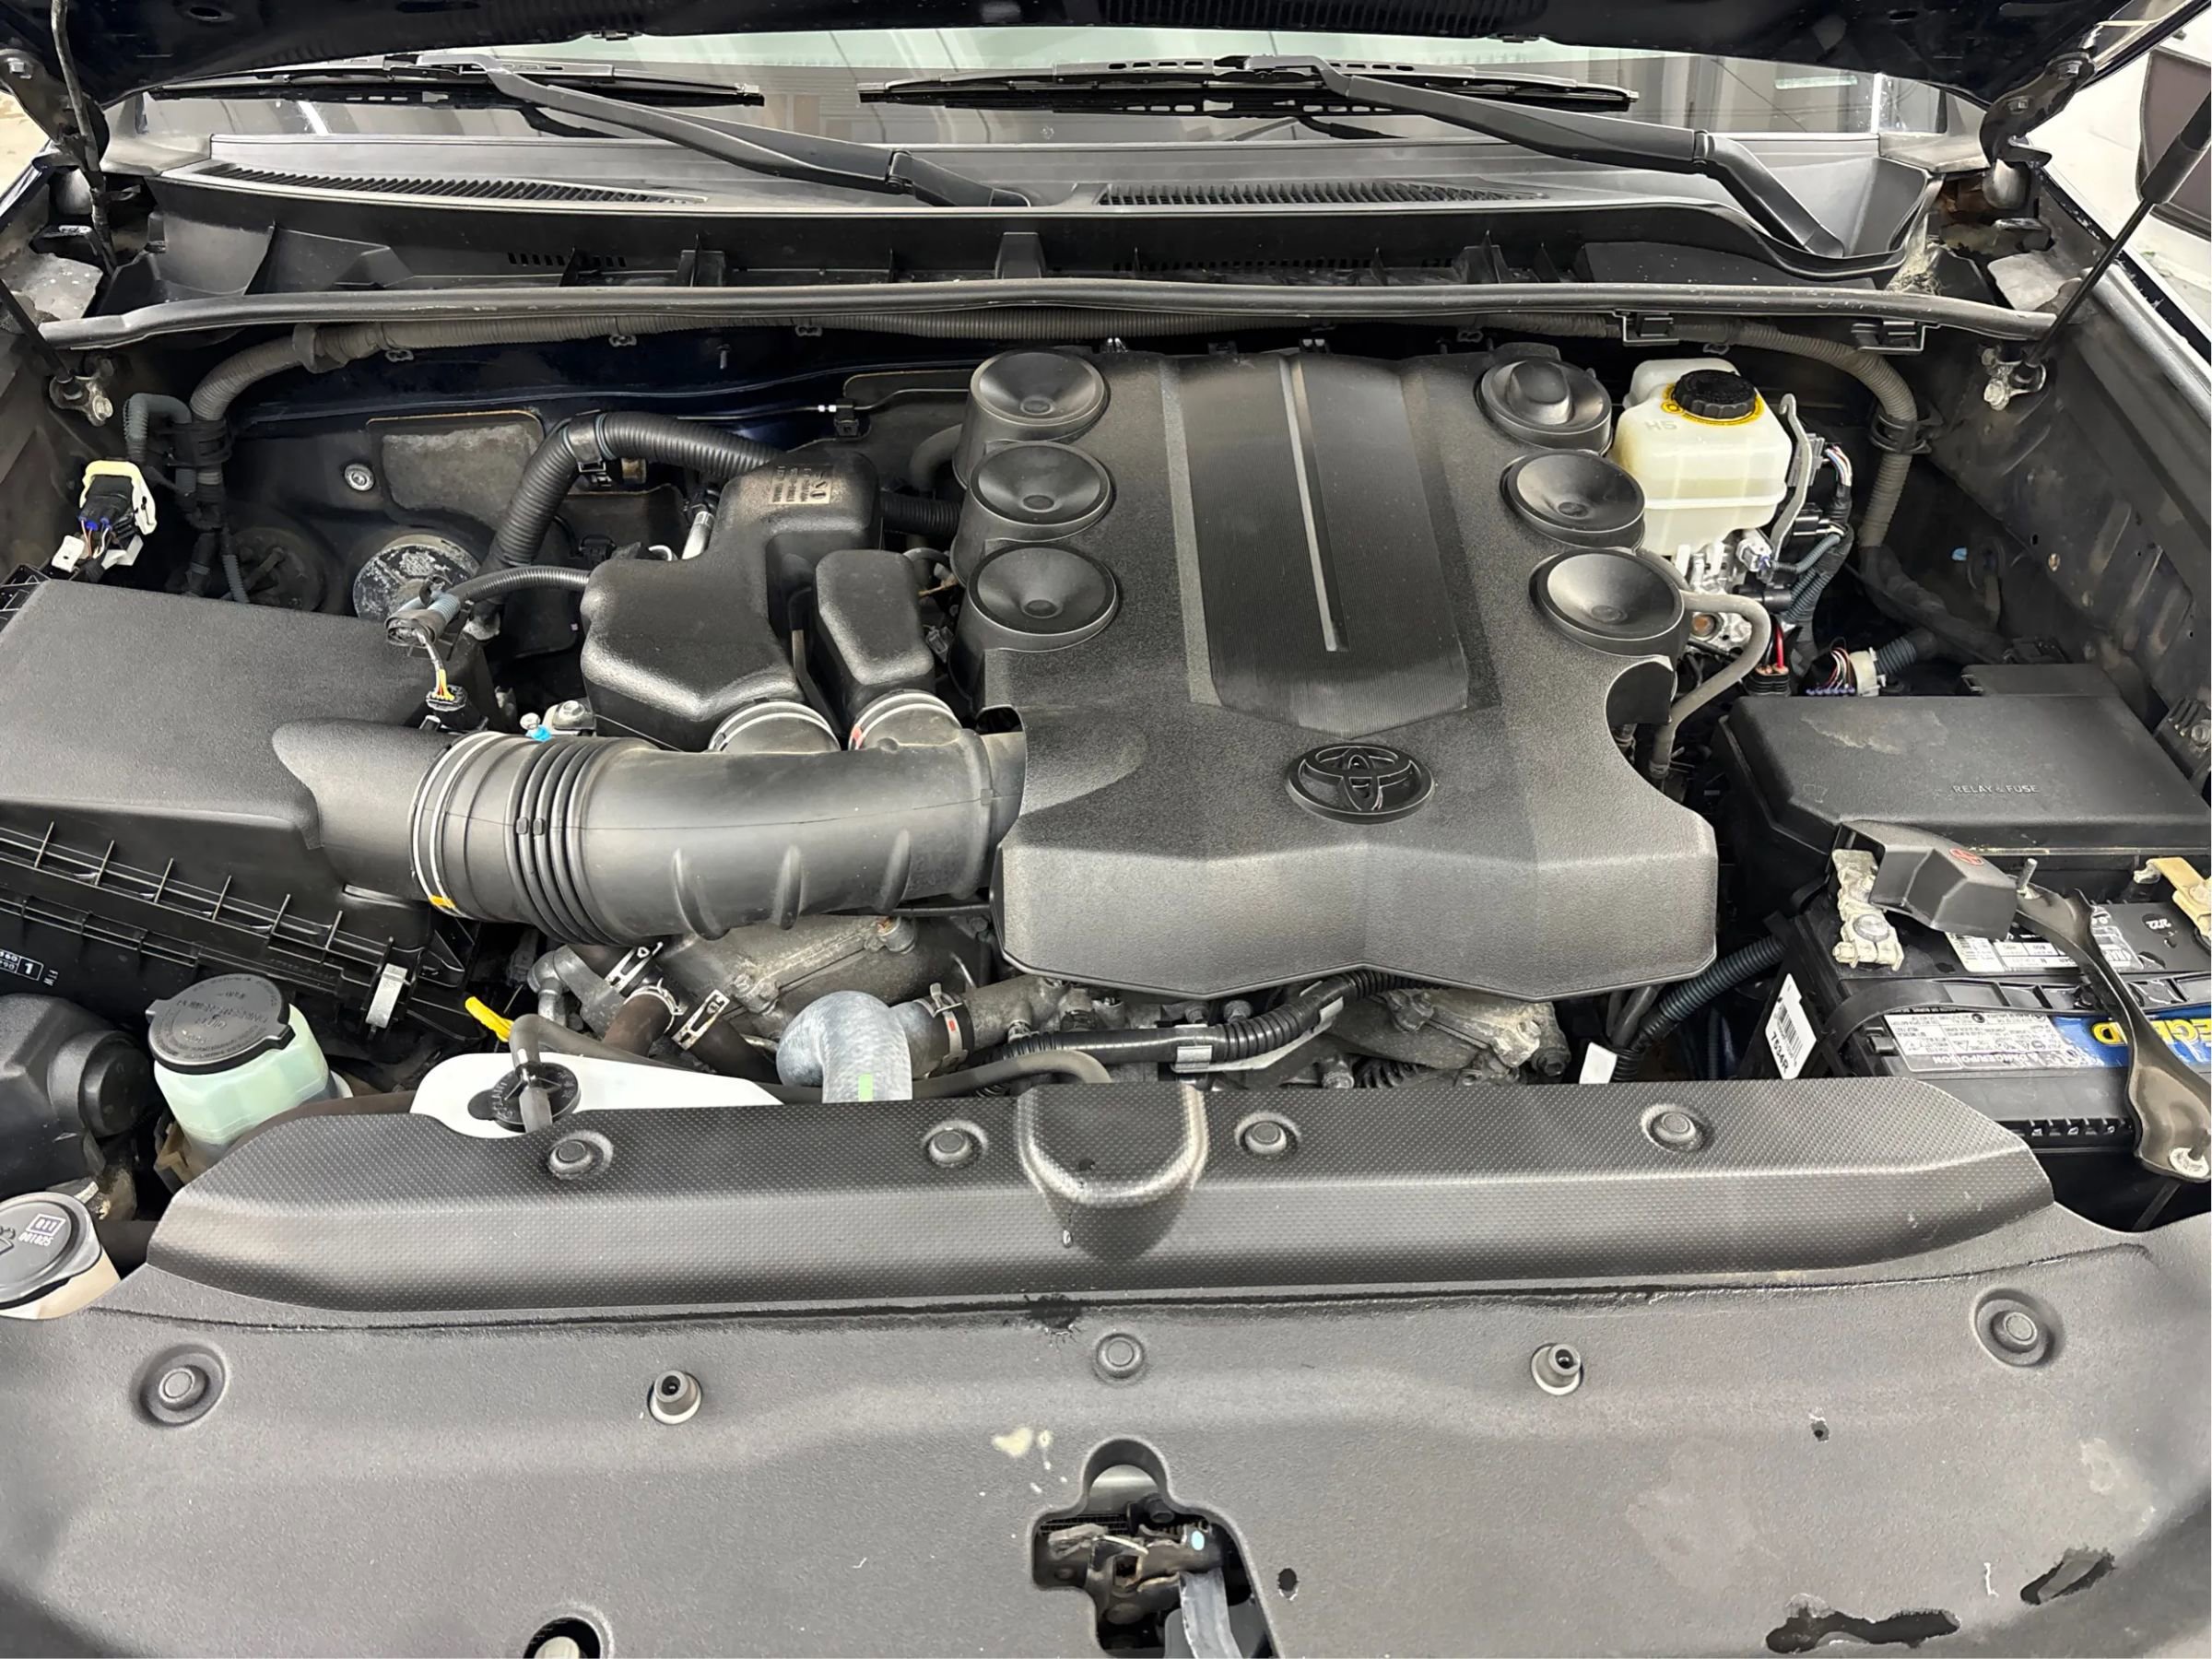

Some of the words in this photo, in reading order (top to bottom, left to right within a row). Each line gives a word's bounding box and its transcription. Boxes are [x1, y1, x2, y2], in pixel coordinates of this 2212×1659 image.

[1953, 784, 1993, 794] RELAY
[2006, 784, 2040, 794] FUSE
[24, 962, 34, 975] 1
